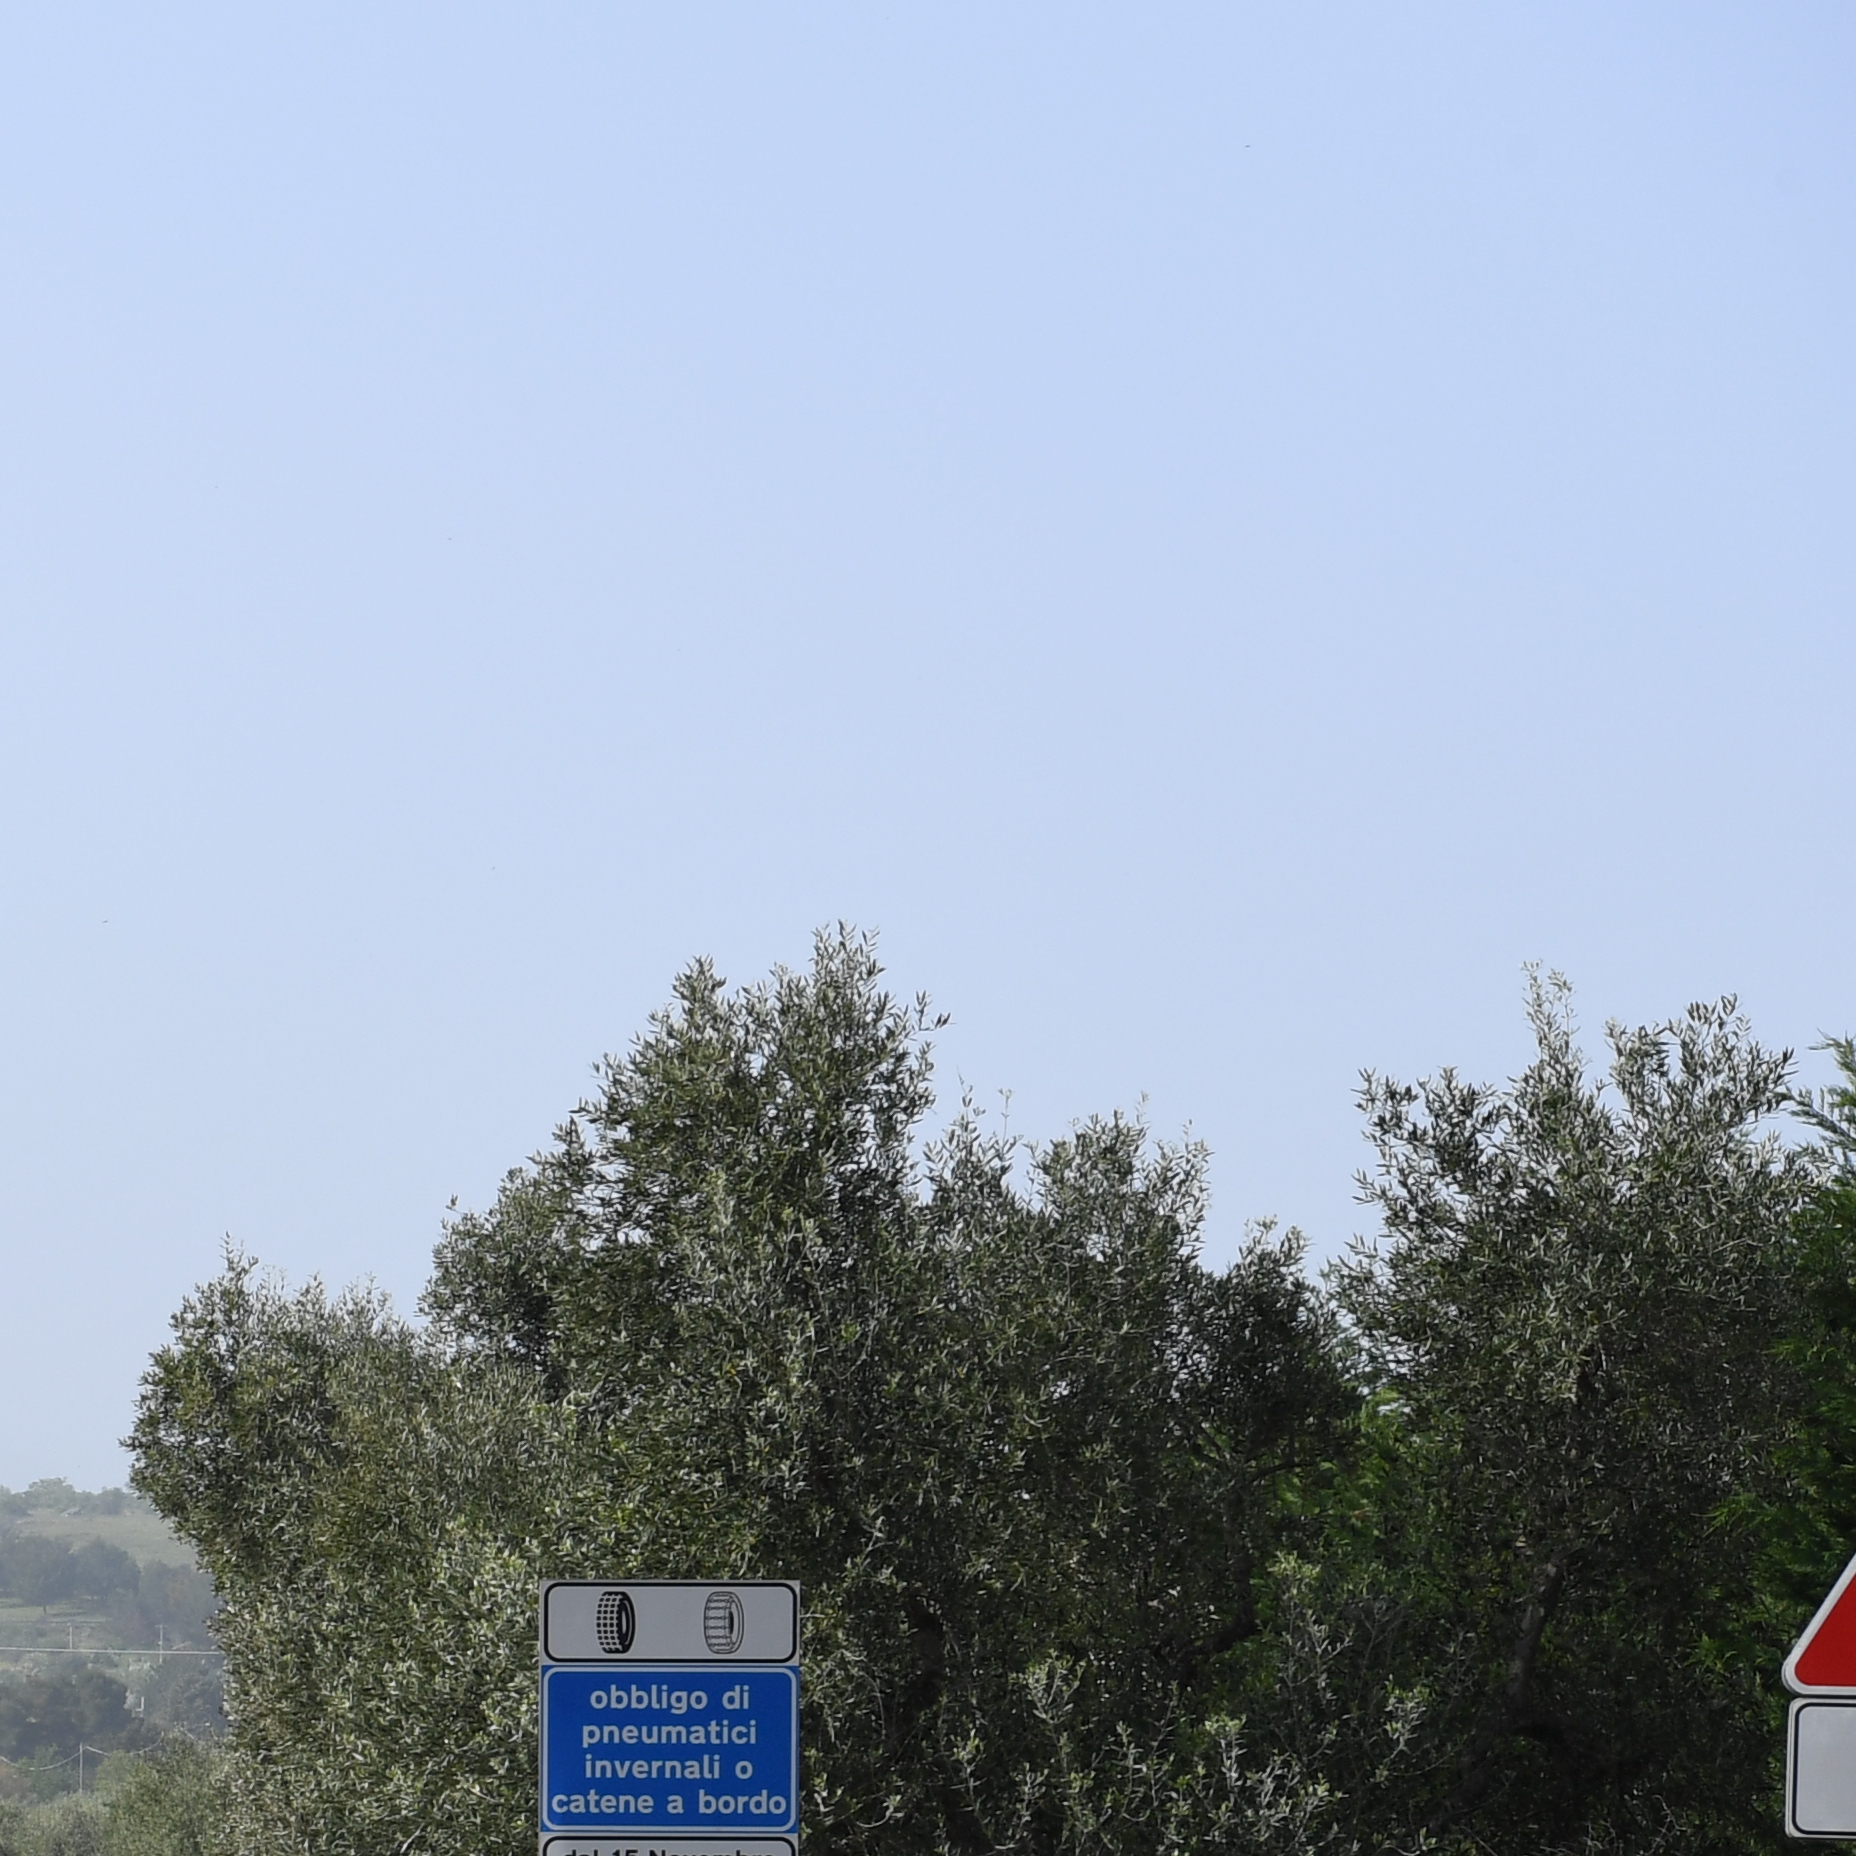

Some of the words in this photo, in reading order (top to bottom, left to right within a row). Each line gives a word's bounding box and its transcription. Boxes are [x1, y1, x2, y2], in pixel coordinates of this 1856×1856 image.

[590, 1684, 708, 1715] obbligo
[722, 1684, 750, 1710] di
[582, 1719, 757, 1749] pneumatici
[585, 1753, 720, 1779] invernali
[735, 1760, 753, 1780] o
[551, 1789, 654, 1814] catene
[666, 1795, 685, 1814] a
[698, 1788, 787, 1815] bordo
